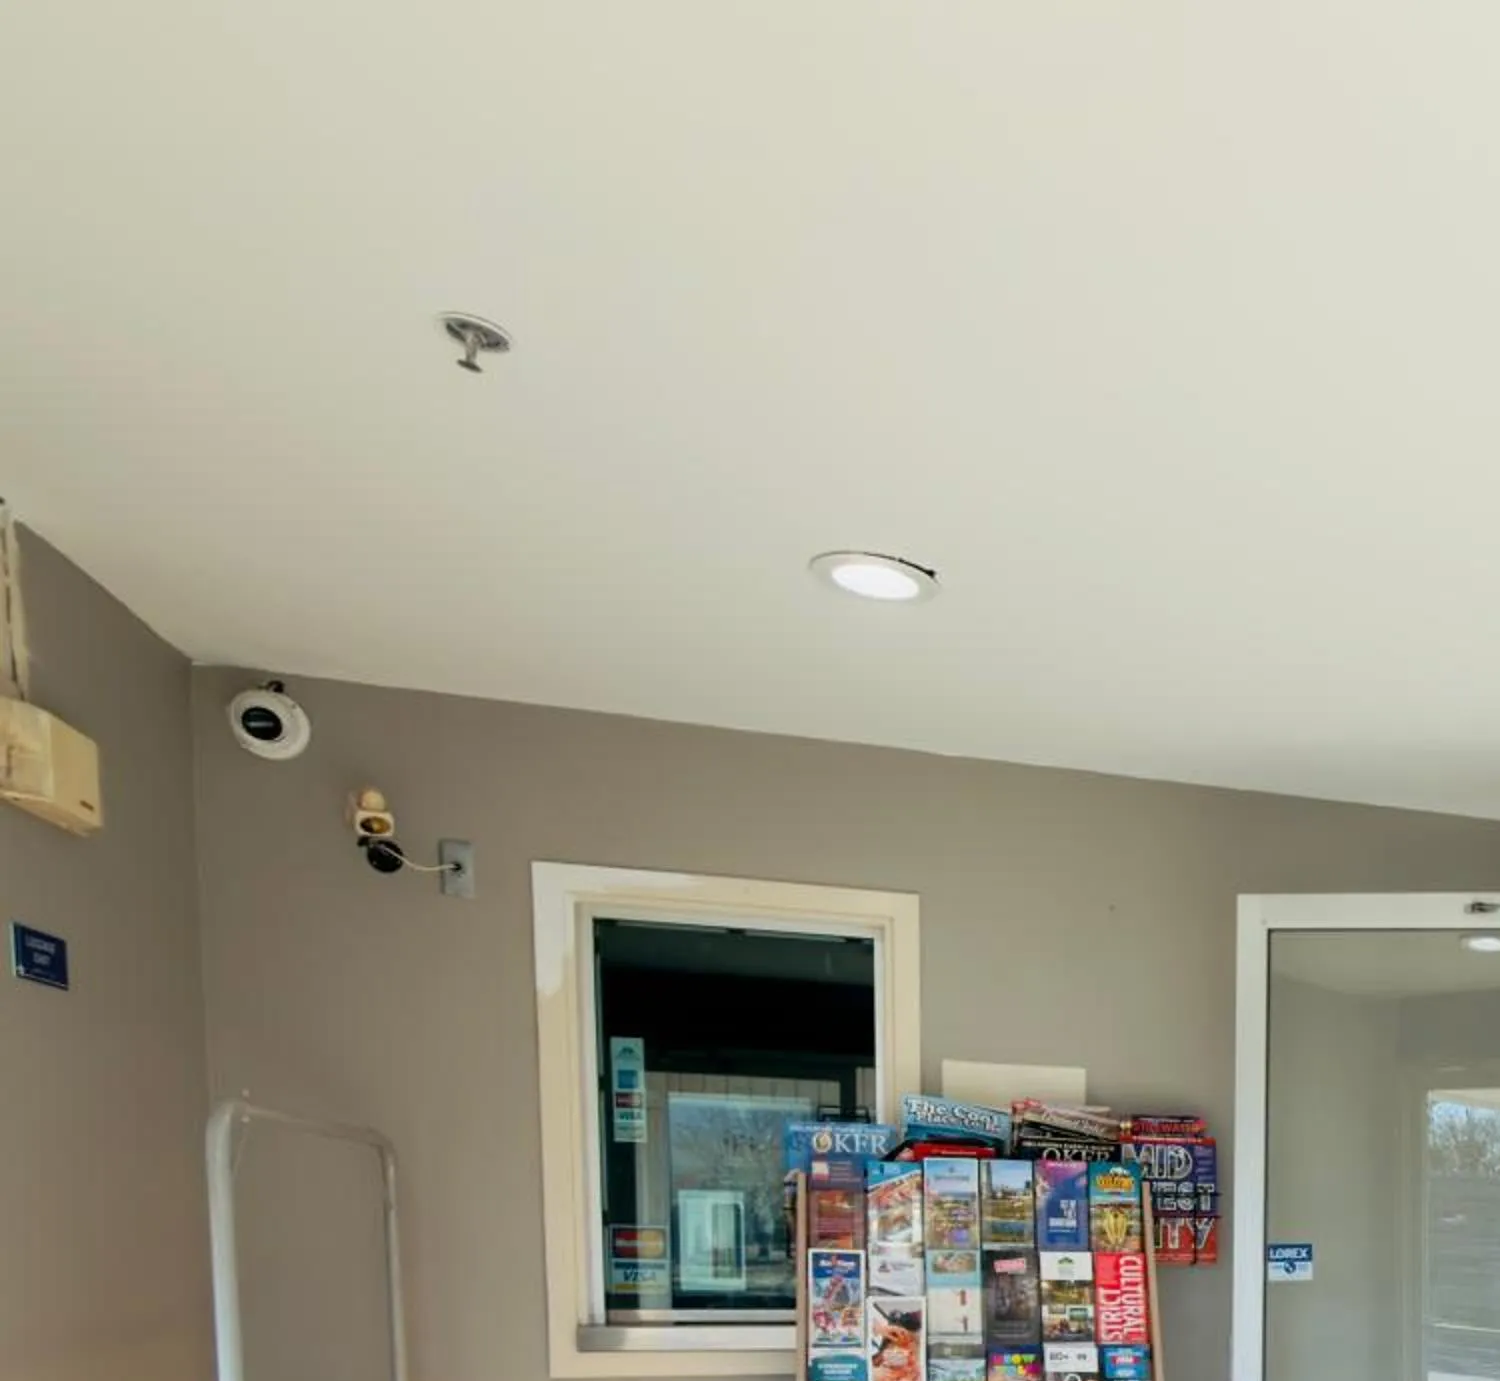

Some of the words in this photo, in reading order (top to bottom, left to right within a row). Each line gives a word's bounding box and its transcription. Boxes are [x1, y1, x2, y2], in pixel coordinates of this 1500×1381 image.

[1152, 1181, 1215, 1211] EST
[1153, 1217, 1216, 1250] ITY
[1098, 1287, 1123, 1344] STRICT
